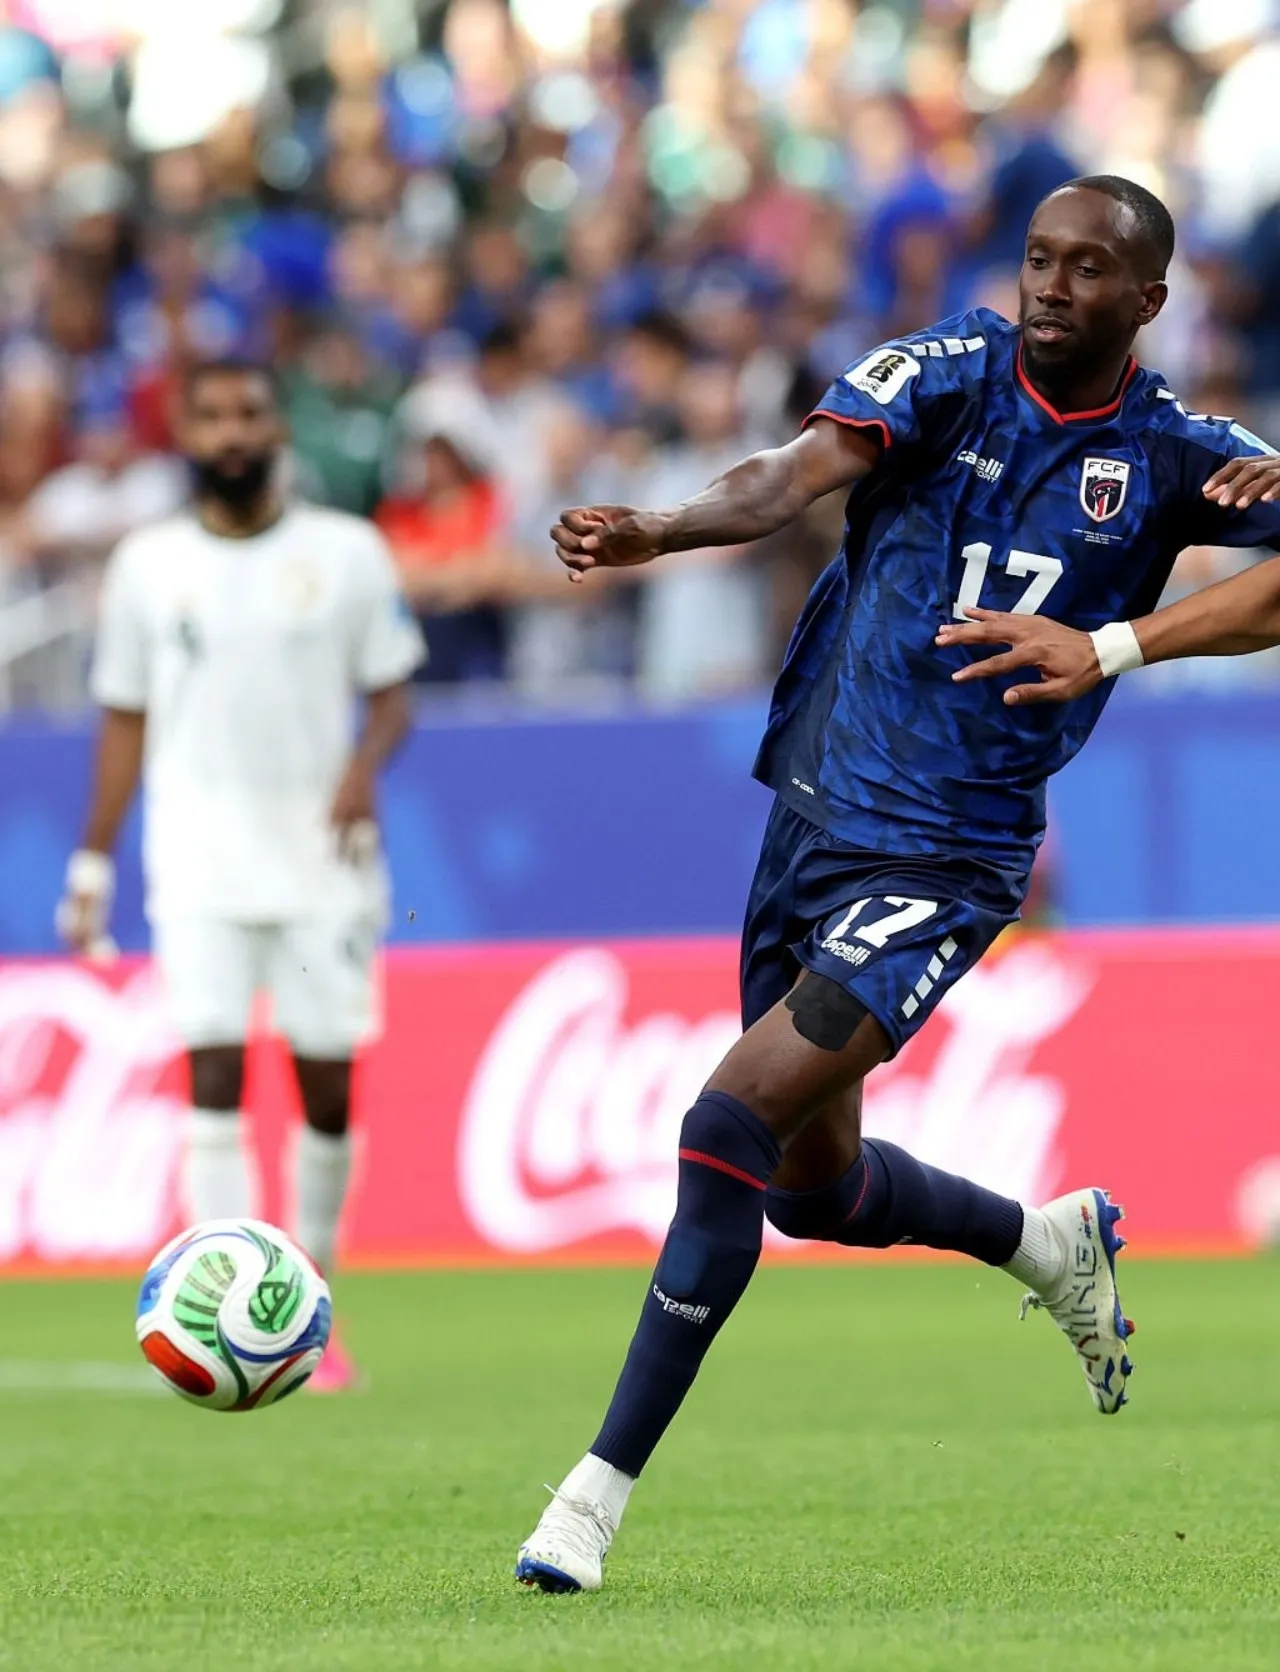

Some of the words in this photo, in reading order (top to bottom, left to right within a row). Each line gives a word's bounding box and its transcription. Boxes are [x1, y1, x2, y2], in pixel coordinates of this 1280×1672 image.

[957, 450, 1005, 479] caelli
[1087, 461, 1126, 474] FCF
[952, 541, 1064, 623] 17
[826, 895, 939, 949] 17
[821, 939, 871, 963] capelli
[653, 1284, 710, 1319] capelli
